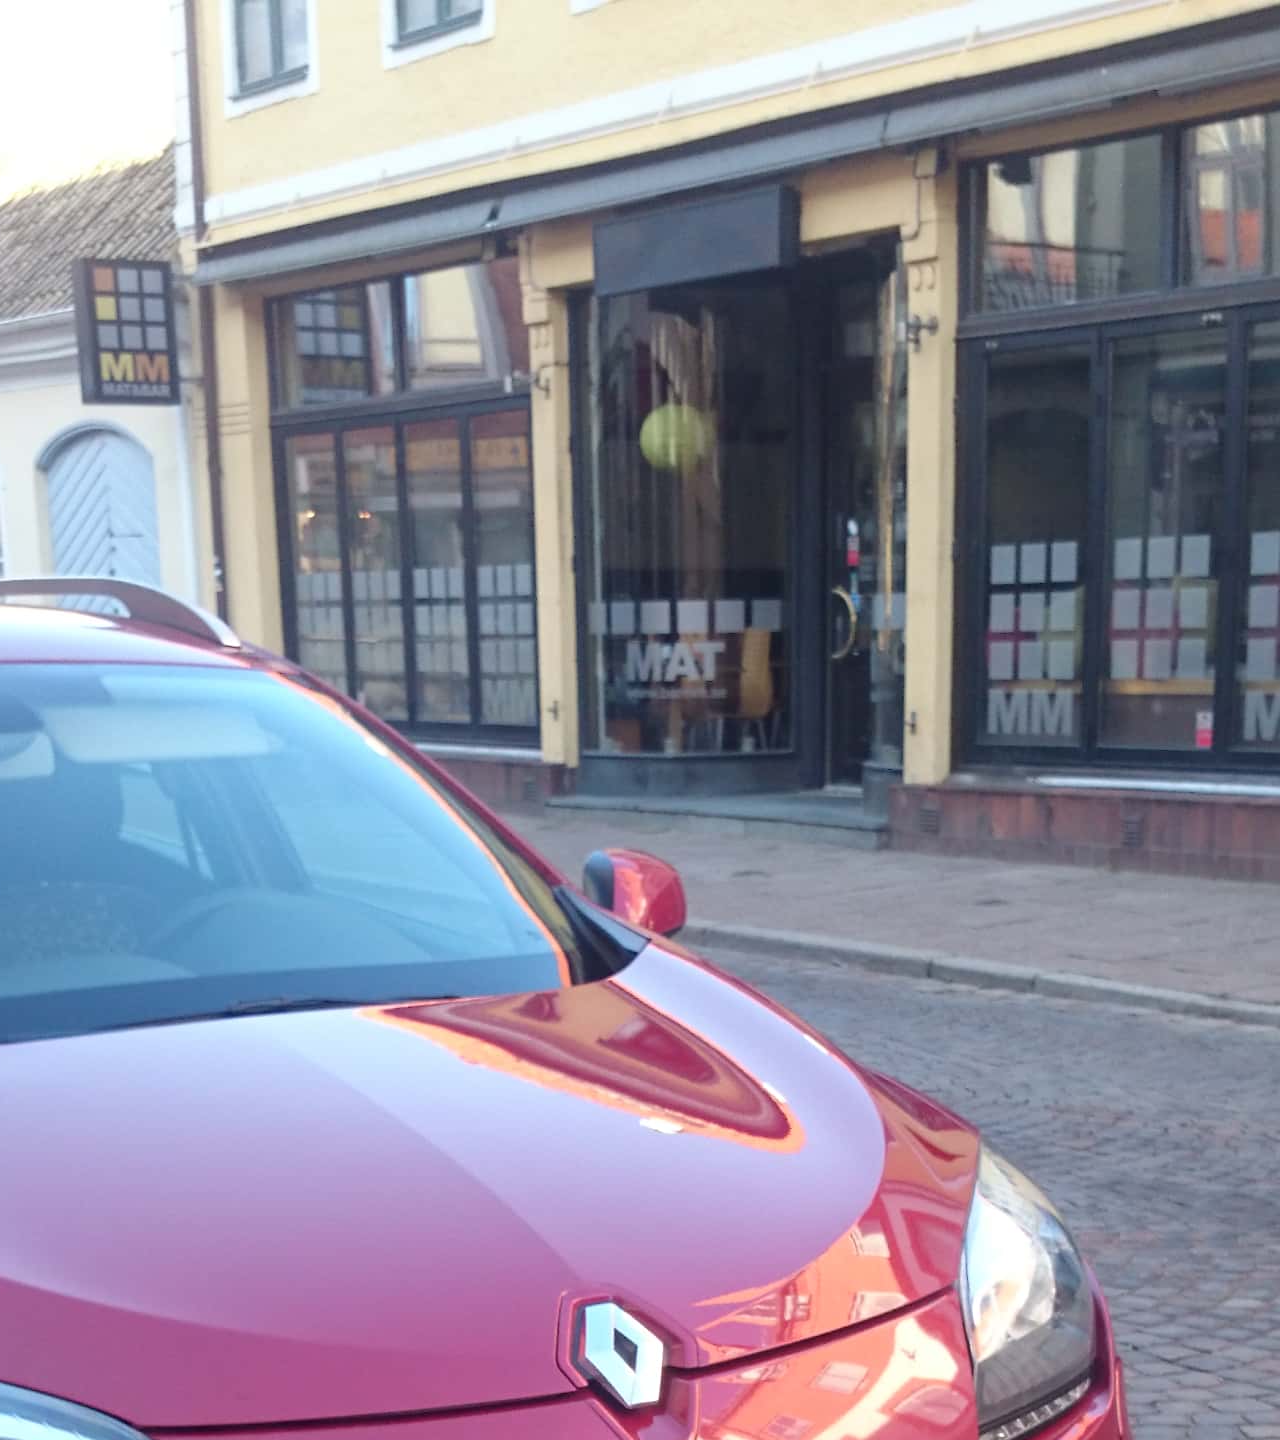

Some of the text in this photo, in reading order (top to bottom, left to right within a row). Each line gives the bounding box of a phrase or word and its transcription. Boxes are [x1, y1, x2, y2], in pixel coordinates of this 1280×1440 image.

[99, 352, 170, 383] MM
[626, 640, 726, 682] MAT
[987, 689, 1073, 736] MM
